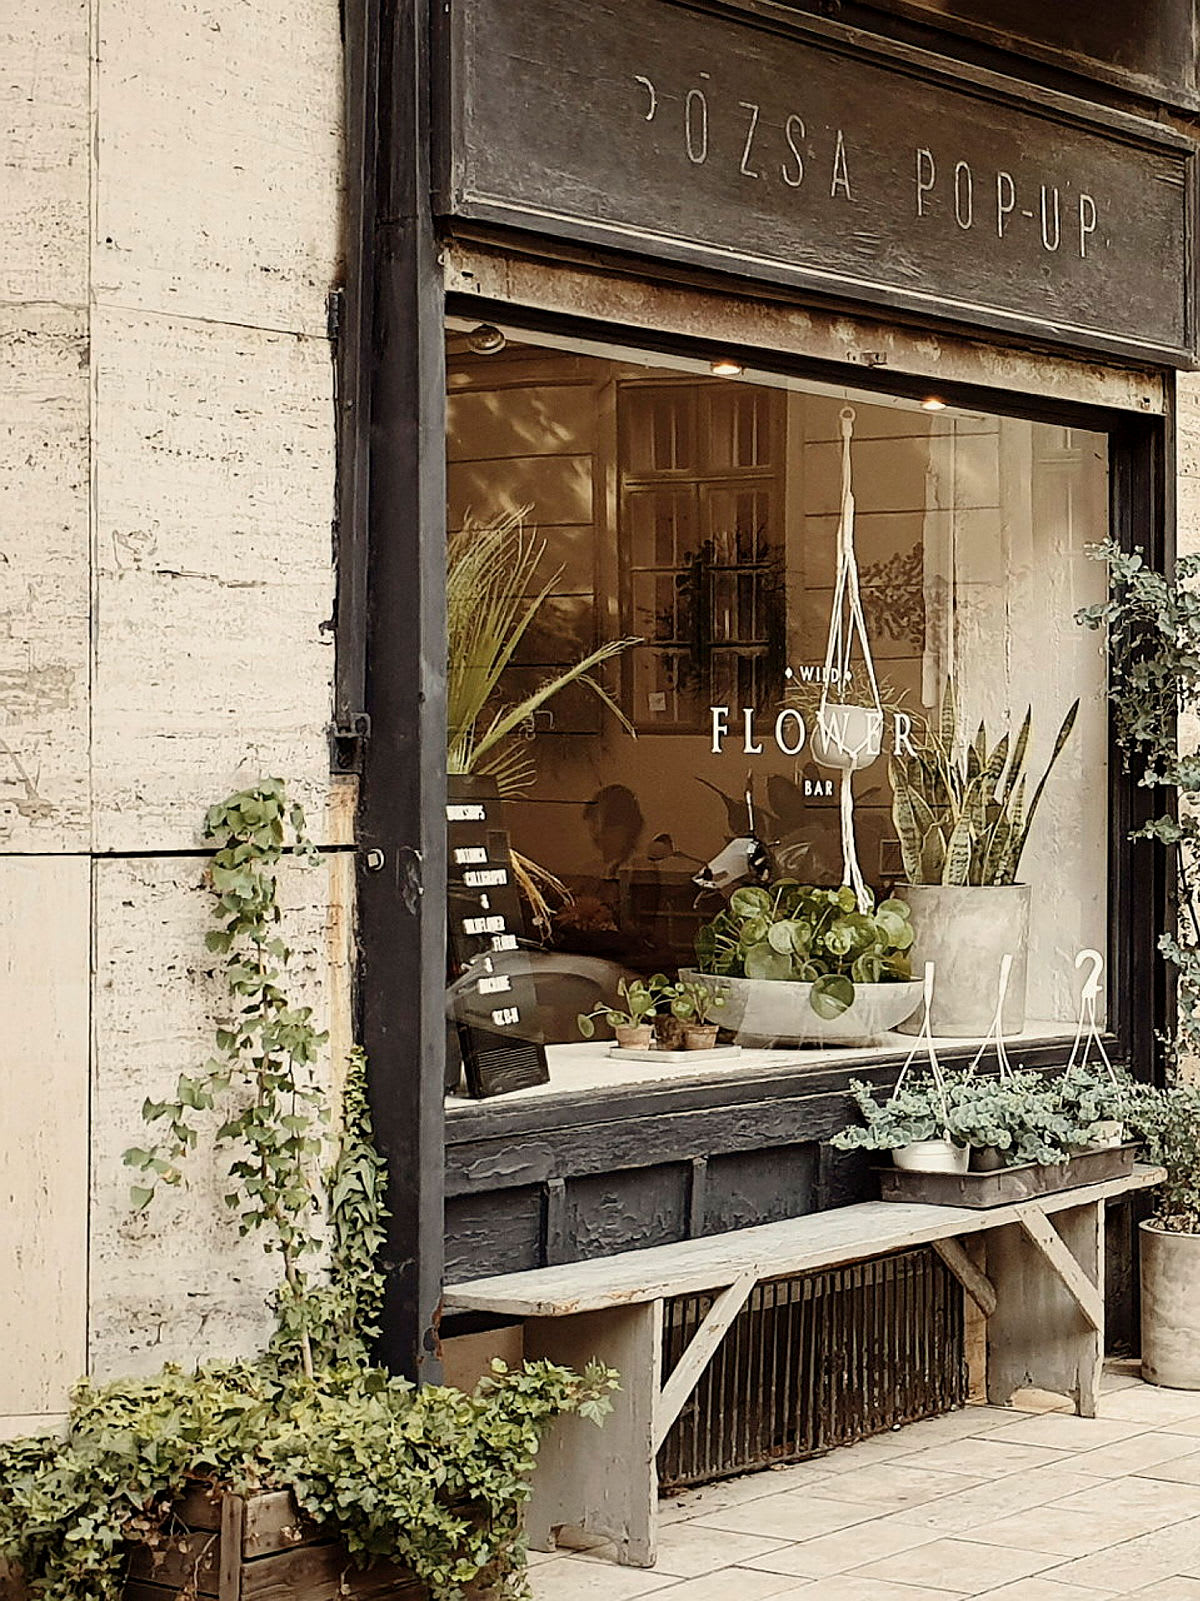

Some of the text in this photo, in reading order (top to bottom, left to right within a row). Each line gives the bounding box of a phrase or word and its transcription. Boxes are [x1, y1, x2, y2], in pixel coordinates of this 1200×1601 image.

[917, 148, 1097, 258] POP-UP
[799, 665, 839, 684] WILD
[710, 706, 919, 757] FLOWER
[804, 780, 833, 797] BAR
